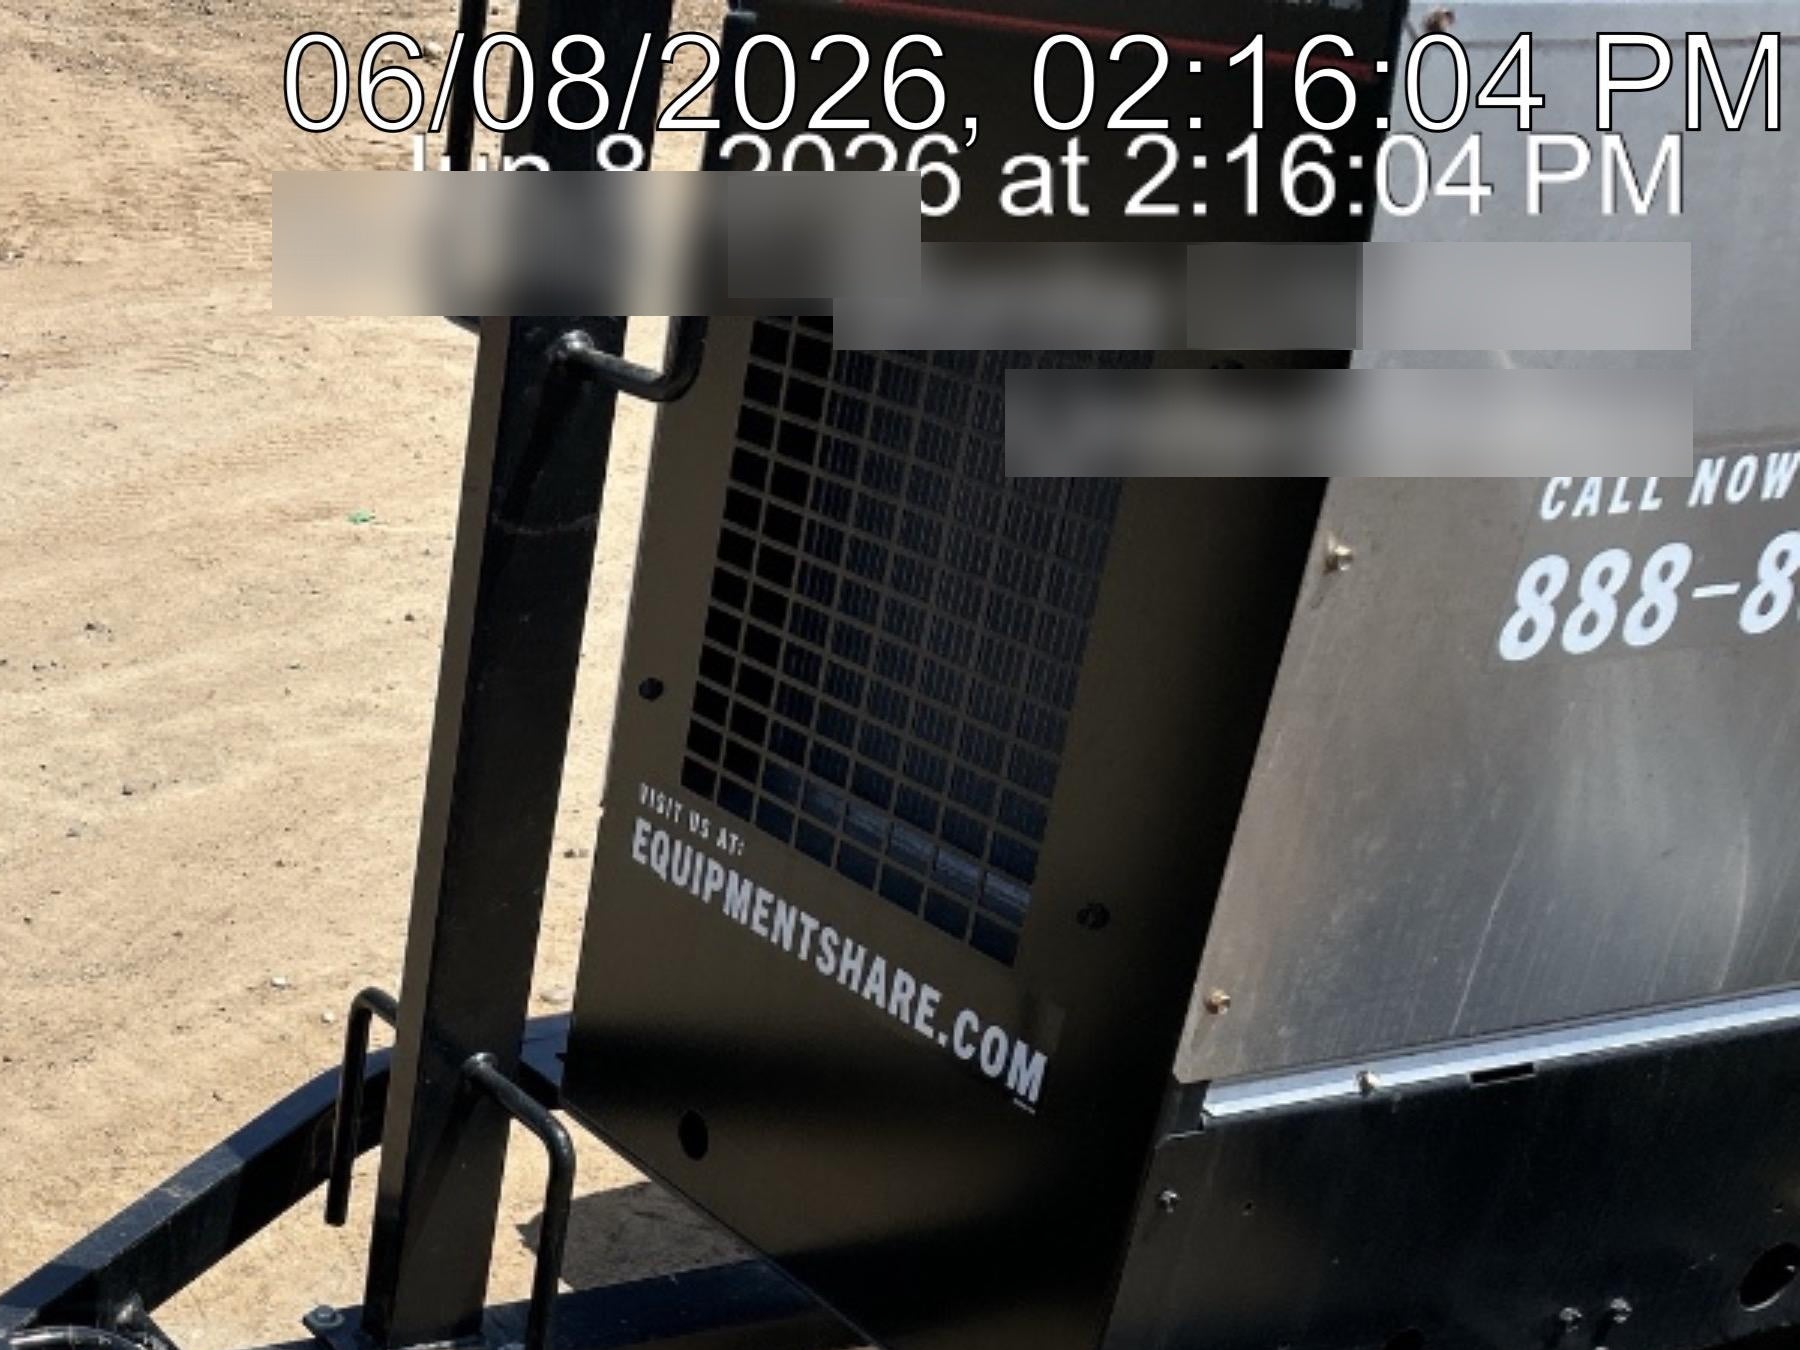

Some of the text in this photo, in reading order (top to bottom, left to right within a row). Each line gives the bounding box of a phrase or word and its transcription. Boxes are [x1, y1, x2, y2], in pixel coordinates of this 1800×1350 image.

[1539, 450, 1800, 520] CALL NOW
[1499, 530, 1800, 661] 888-8
[640, 783, 745, 856] VISIT US AT:
[631, 816, 1048, 1103] EQUIPMENTSHARE.COM
